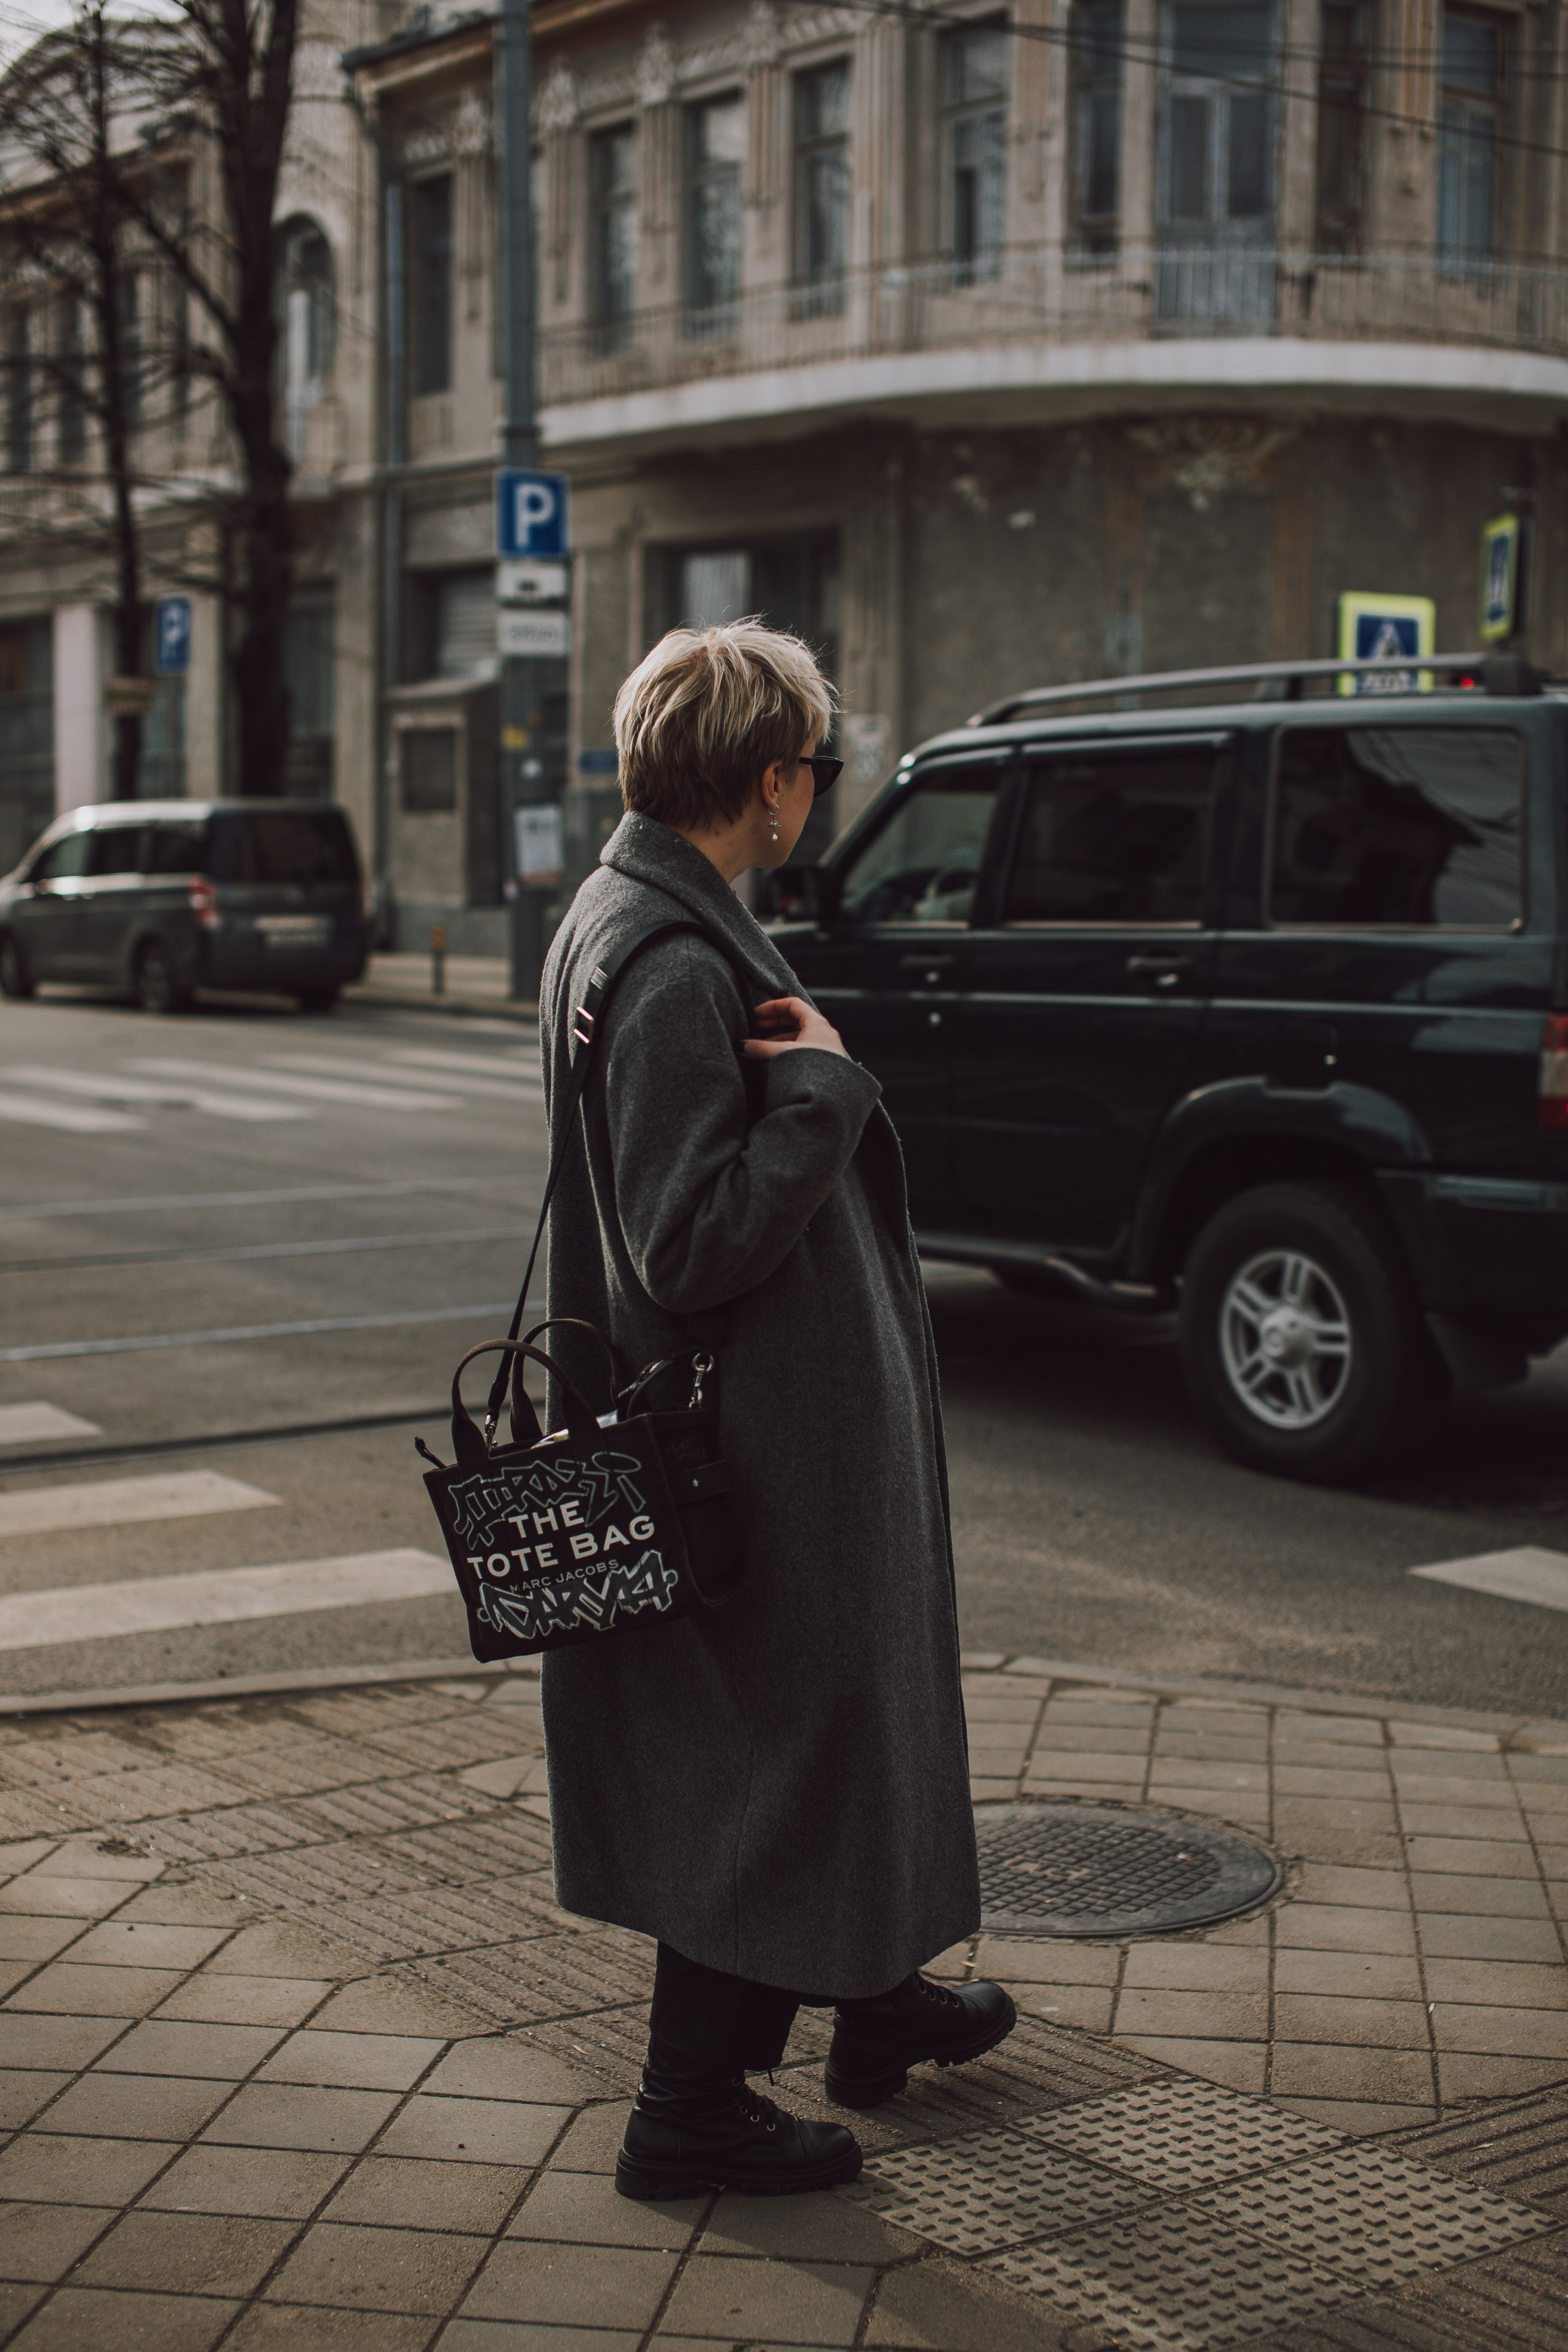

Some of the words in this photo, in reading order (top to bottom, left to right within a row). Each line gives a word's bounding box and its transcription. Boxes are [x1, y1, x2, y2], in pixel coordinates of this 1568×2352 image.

[516, 482, 555, 547] P
[508, 1499, 585, 1538] THE
[467, 1542, 559, 1579] TOTE
[569, 1515, 655, 1559] BAG
[509, 1576, 551, 1593] MARC
[556, 1559, 619, 1583] JACOBS
